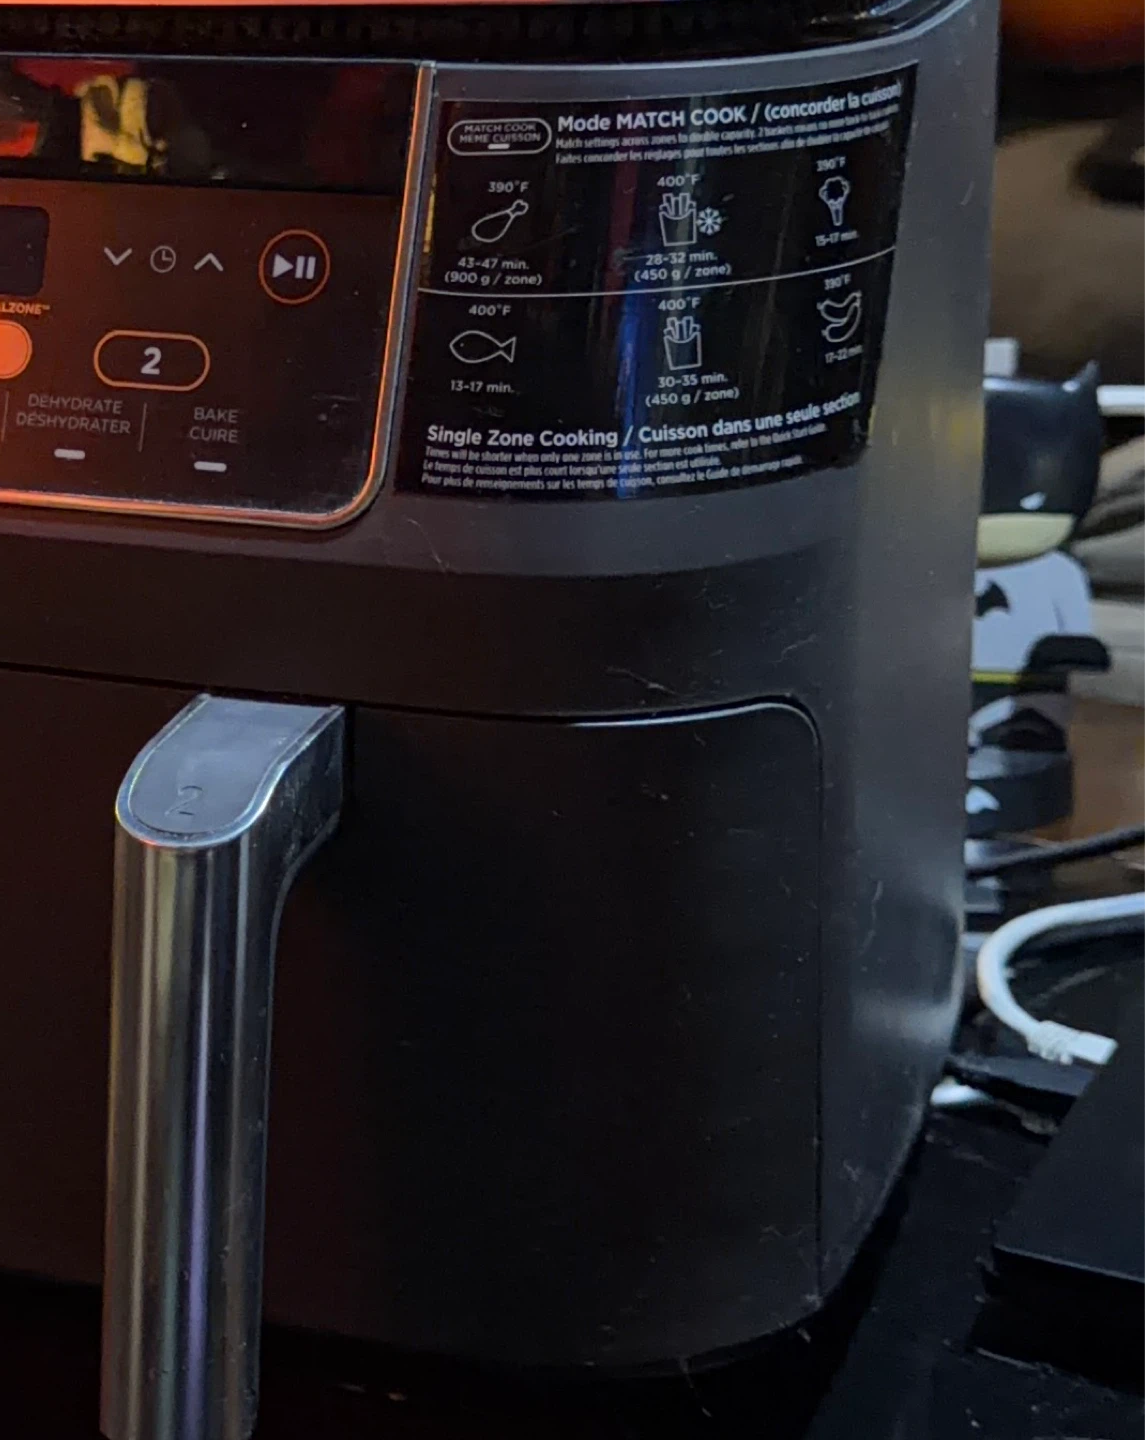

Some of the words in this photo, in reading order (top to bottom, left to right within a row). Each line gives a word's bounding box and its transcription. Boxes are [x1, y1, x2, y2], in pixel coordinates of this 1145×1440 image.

[557, 114, 611, 133] Mode
[616, 110, 685, 130] MATCH
[690, 104, 746, 127] COOK
[750, 102, 761, 124] /
[764, 95, 846, 122] (concorder
[847, 92, 859, 109] la
[464, 124, 502, 133] MATCH
[504, 123, 537, 132] COOK
[492, 132, 542, 144] CUISSON
[458, 257, 498, 270] 43-47
[501, 258, 531, 270] min.
[689, 251, 719, 262] min.
[444, 270, 476, 286] (900
[481, 273, 490, 286] g
[493, 271, 500, 285] /
[504, 270, 543, 286] zone)
[634, 268, 666, 282] (450
[670, 269, 680, 281] g
[694, 262, 733, 277] zone)
[139, 346, 161, 376] 2
[450, 379, 484, 392] 13-17
[486, 381, 515, 394] min.
[657, 374, 699, 389] 30-35
[701, 372, 729, 385] min.
[27, 393, 123, 415] DEHYDRATE
[644, 393, 679, 408] (450
[681, 394, 691, 406] g
[693, 389, 701, 404] /
[704, 385, 741, 402] zone)
[16, 410, 131, 435] DÉSHYDRATER
[193, 406, 239, 424] BAKE
[427, 424, 482, 447] Single
[487, 429, 535, 446] Zone
[539, 428, 619, 448] Cooking
[622, 424, 635, 447] /
[638, 423, 708, 443] Cuisson
[712, 418, 752, 437] dans
[755, 414, 783, 431] une
[785, 402, 820, 425] seule
[189, 426, 240, 445] CUIRE
[644, 448, 659, 460] For
[462, 463, 474, 474] de
